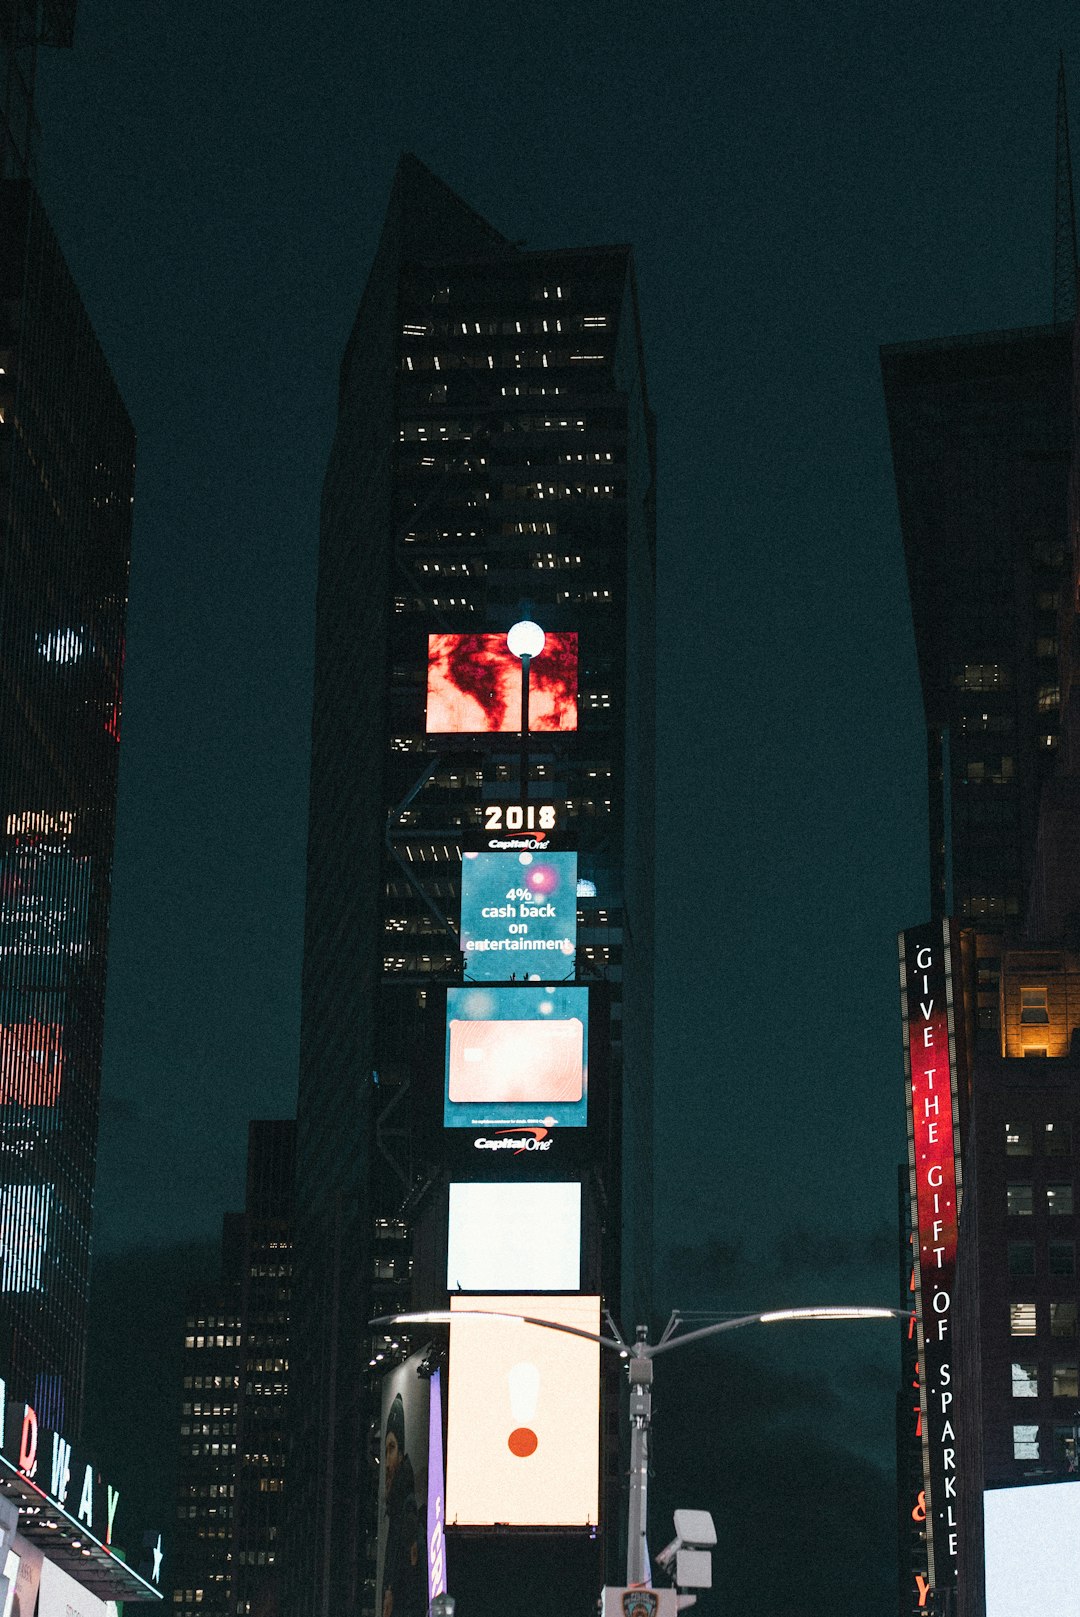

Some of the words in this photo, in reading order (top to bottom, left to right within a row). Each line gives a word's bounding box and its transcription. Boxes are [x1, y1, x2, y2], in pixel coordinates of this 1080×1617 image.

[485, 806, 556, 829] 2018
[481, 903, 517, 918] cash
[519, 903, 556, 918] back
[505, 888, 532, 901] 4%
[466, 937, 571, 951] entertainment
[508, 923, 528, 934] on
[916, 947, 934, 1048] GIVE
[924, 1068, 940, 1144] THE
[927, 1165, 946, 1269] GIFT
[932, 1291, 951, 1341] OF
[939, 1364, 958, 1555] SPARKLE
